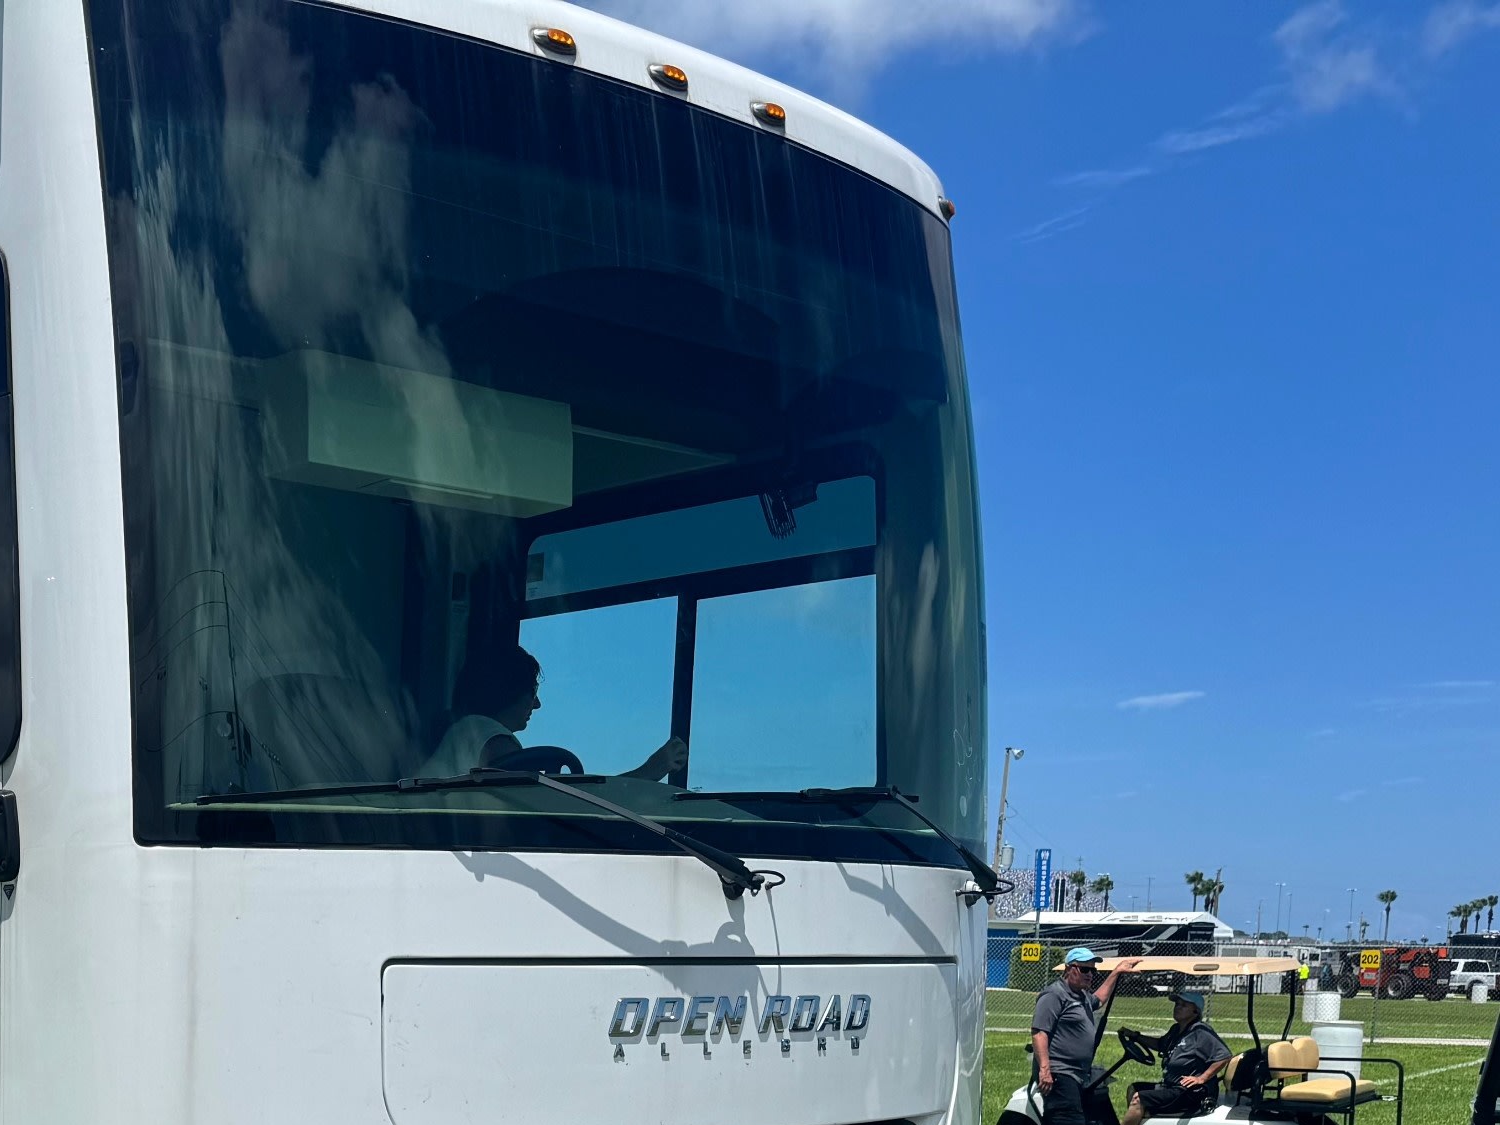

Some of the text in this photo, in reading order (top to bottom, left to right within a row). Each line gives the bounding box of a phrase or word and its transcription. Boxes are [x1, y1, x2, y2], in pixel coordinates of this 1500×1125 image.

[1039, 860, 1047, 907] RESTROOMS
[1023, 947, 1039, 957] 203
[1361, 954, 1379, 965] 202
[608, 994, 872, 1038] OPEN ROAD
[613, 1036, 860, 1058] ALLEGRO
